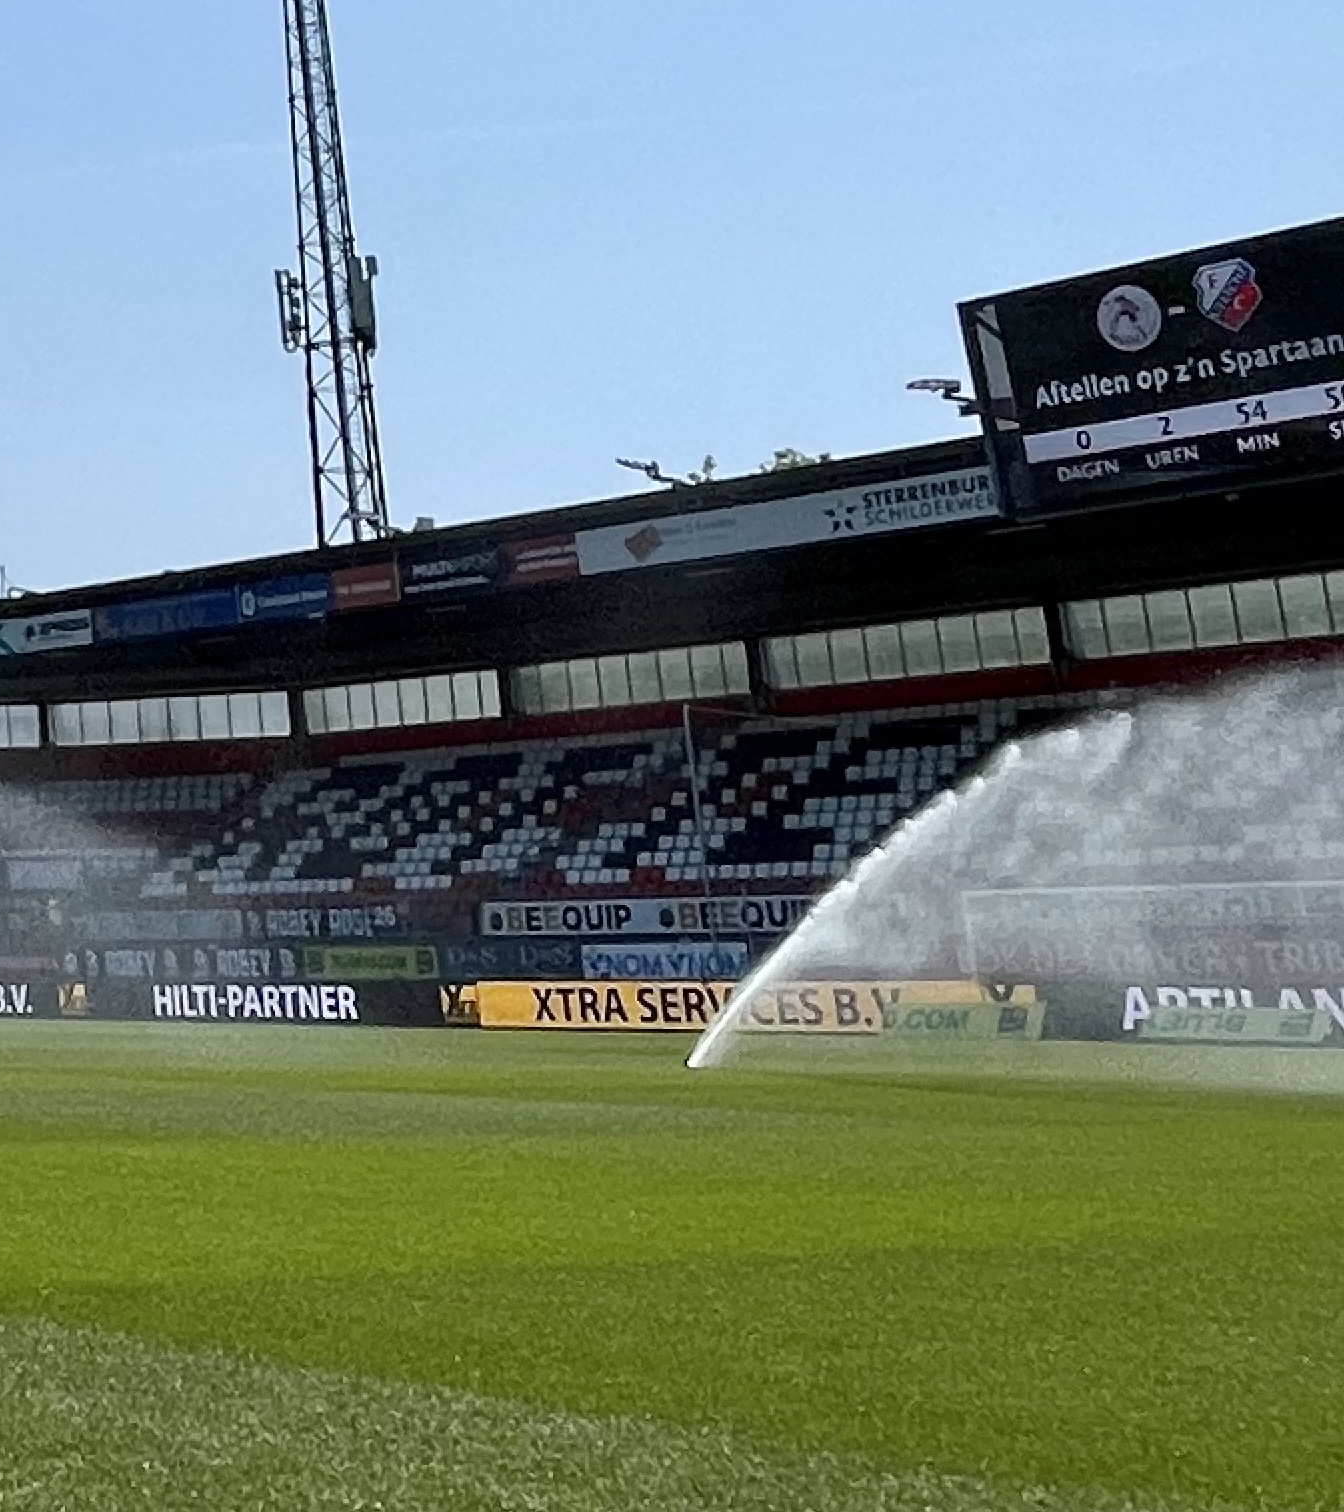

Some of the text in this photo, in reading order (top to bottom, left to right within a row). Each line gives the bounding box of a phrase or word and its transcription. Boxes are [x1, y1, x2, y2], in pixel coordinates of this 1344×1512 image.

[1036, 374, 1130, 409] Aftellen
[1137, 367, 1168, 393] op
[1173, 357, 1215, 381] z'n
[1076, 385, 1344, 450] 0 2 54 5
[1057, 459, 1120, 482] DAGEN
[1145, 445, 1199, 469] UREN
[1236, 432, 1280, 453] MIN
[506, 903, 632, 931] BEEQUIP
[152, 983, 360, 1021] HILTI-PARTNER
[531, 987, 628, 1023] XTRA
[638, 986, 822, 1026] SERVCES
